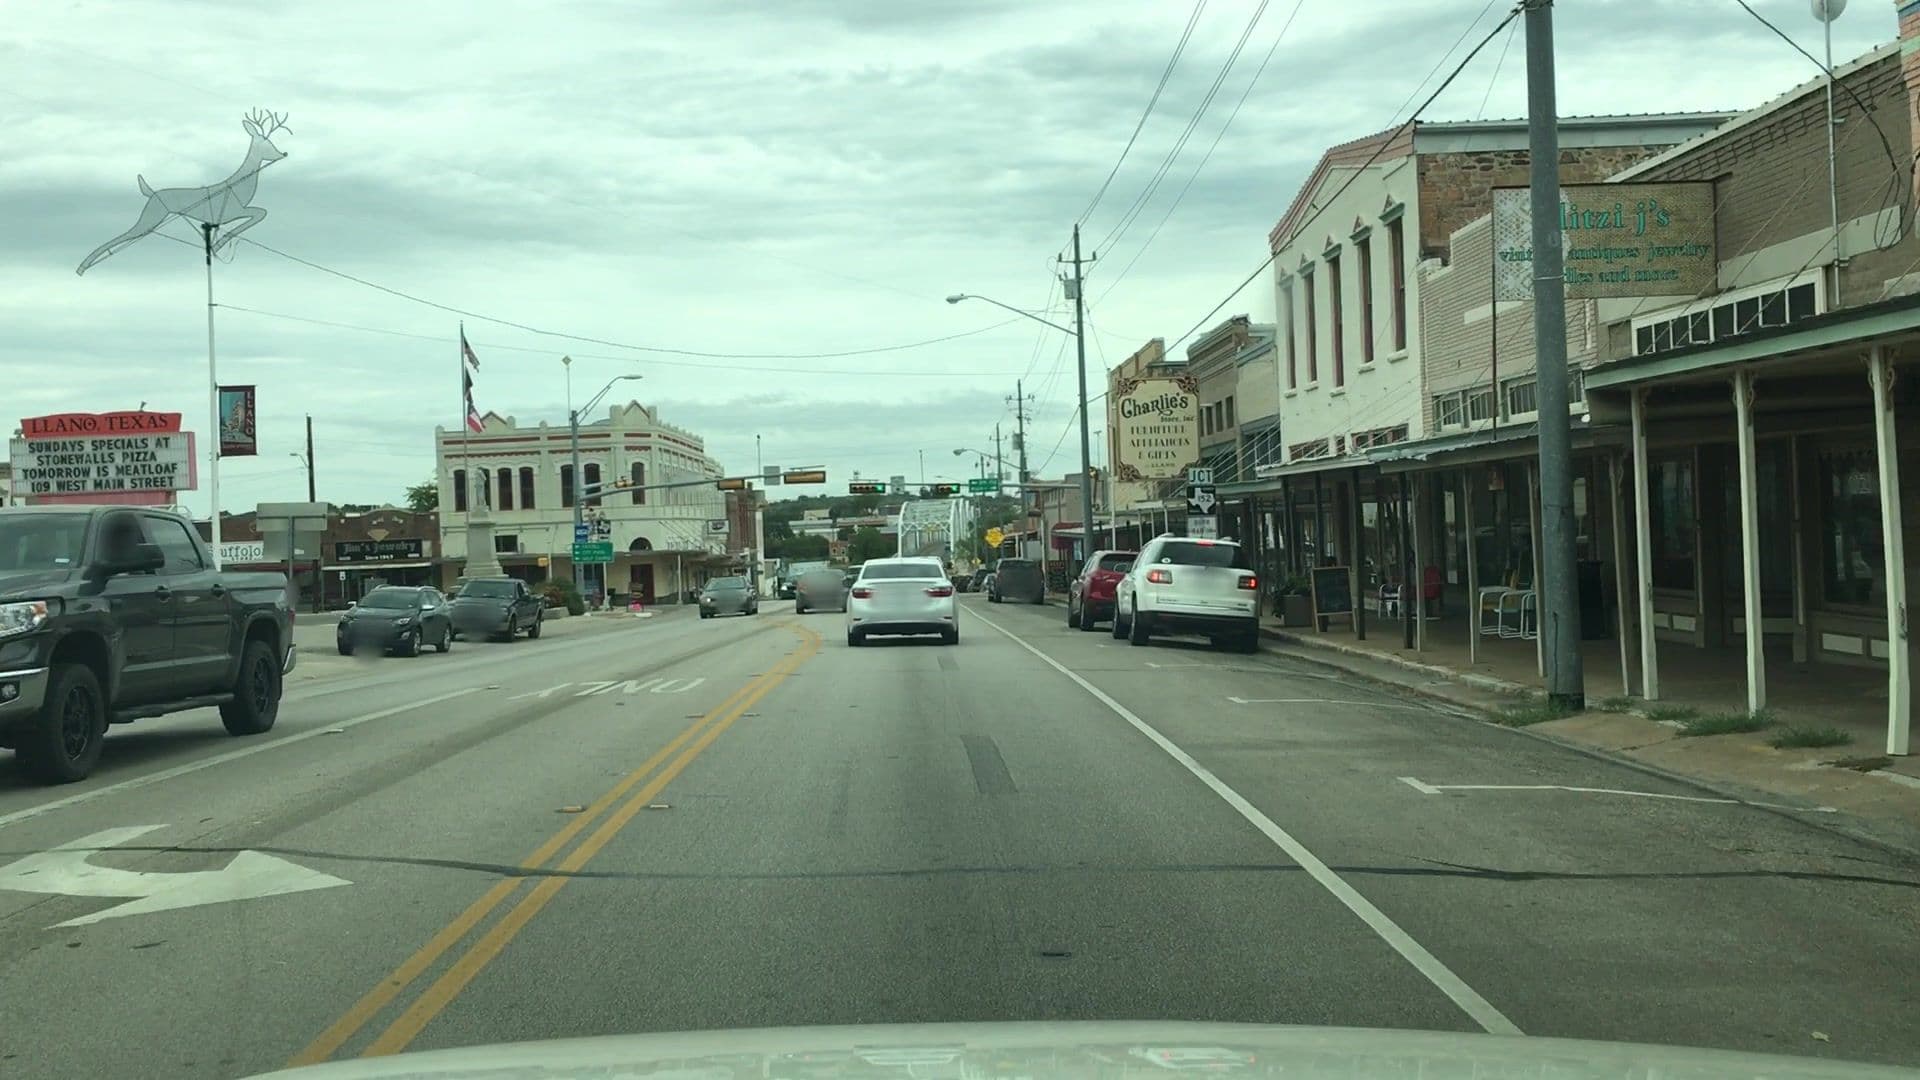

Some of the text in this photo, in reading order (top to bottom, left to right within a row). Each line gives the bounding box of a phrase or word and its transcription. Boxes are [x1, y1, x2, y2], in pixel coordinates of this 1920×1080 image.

[1559, 198, 1670, 236] itzi j's
[1499, 246, 1533, 262] vint
[1568, 246, 1640, 263] antiques
[1635, 269, 1679, 281] more
[1121, 392, 1189, 418] Charlie's
[106, 414, 168, 430] TEXAS
[28, 437, 170, 454] SUNDAYS SPECIALS AT
[37, 451, 157, 466] STONEWALLS PIZZA
[22, 463, 178, 480] TOMORROW IS MEATLOAF
[1190, 470, 1212, 482] JCT
[31, 476, 174, 493] 109 WEST MAIN STREET
